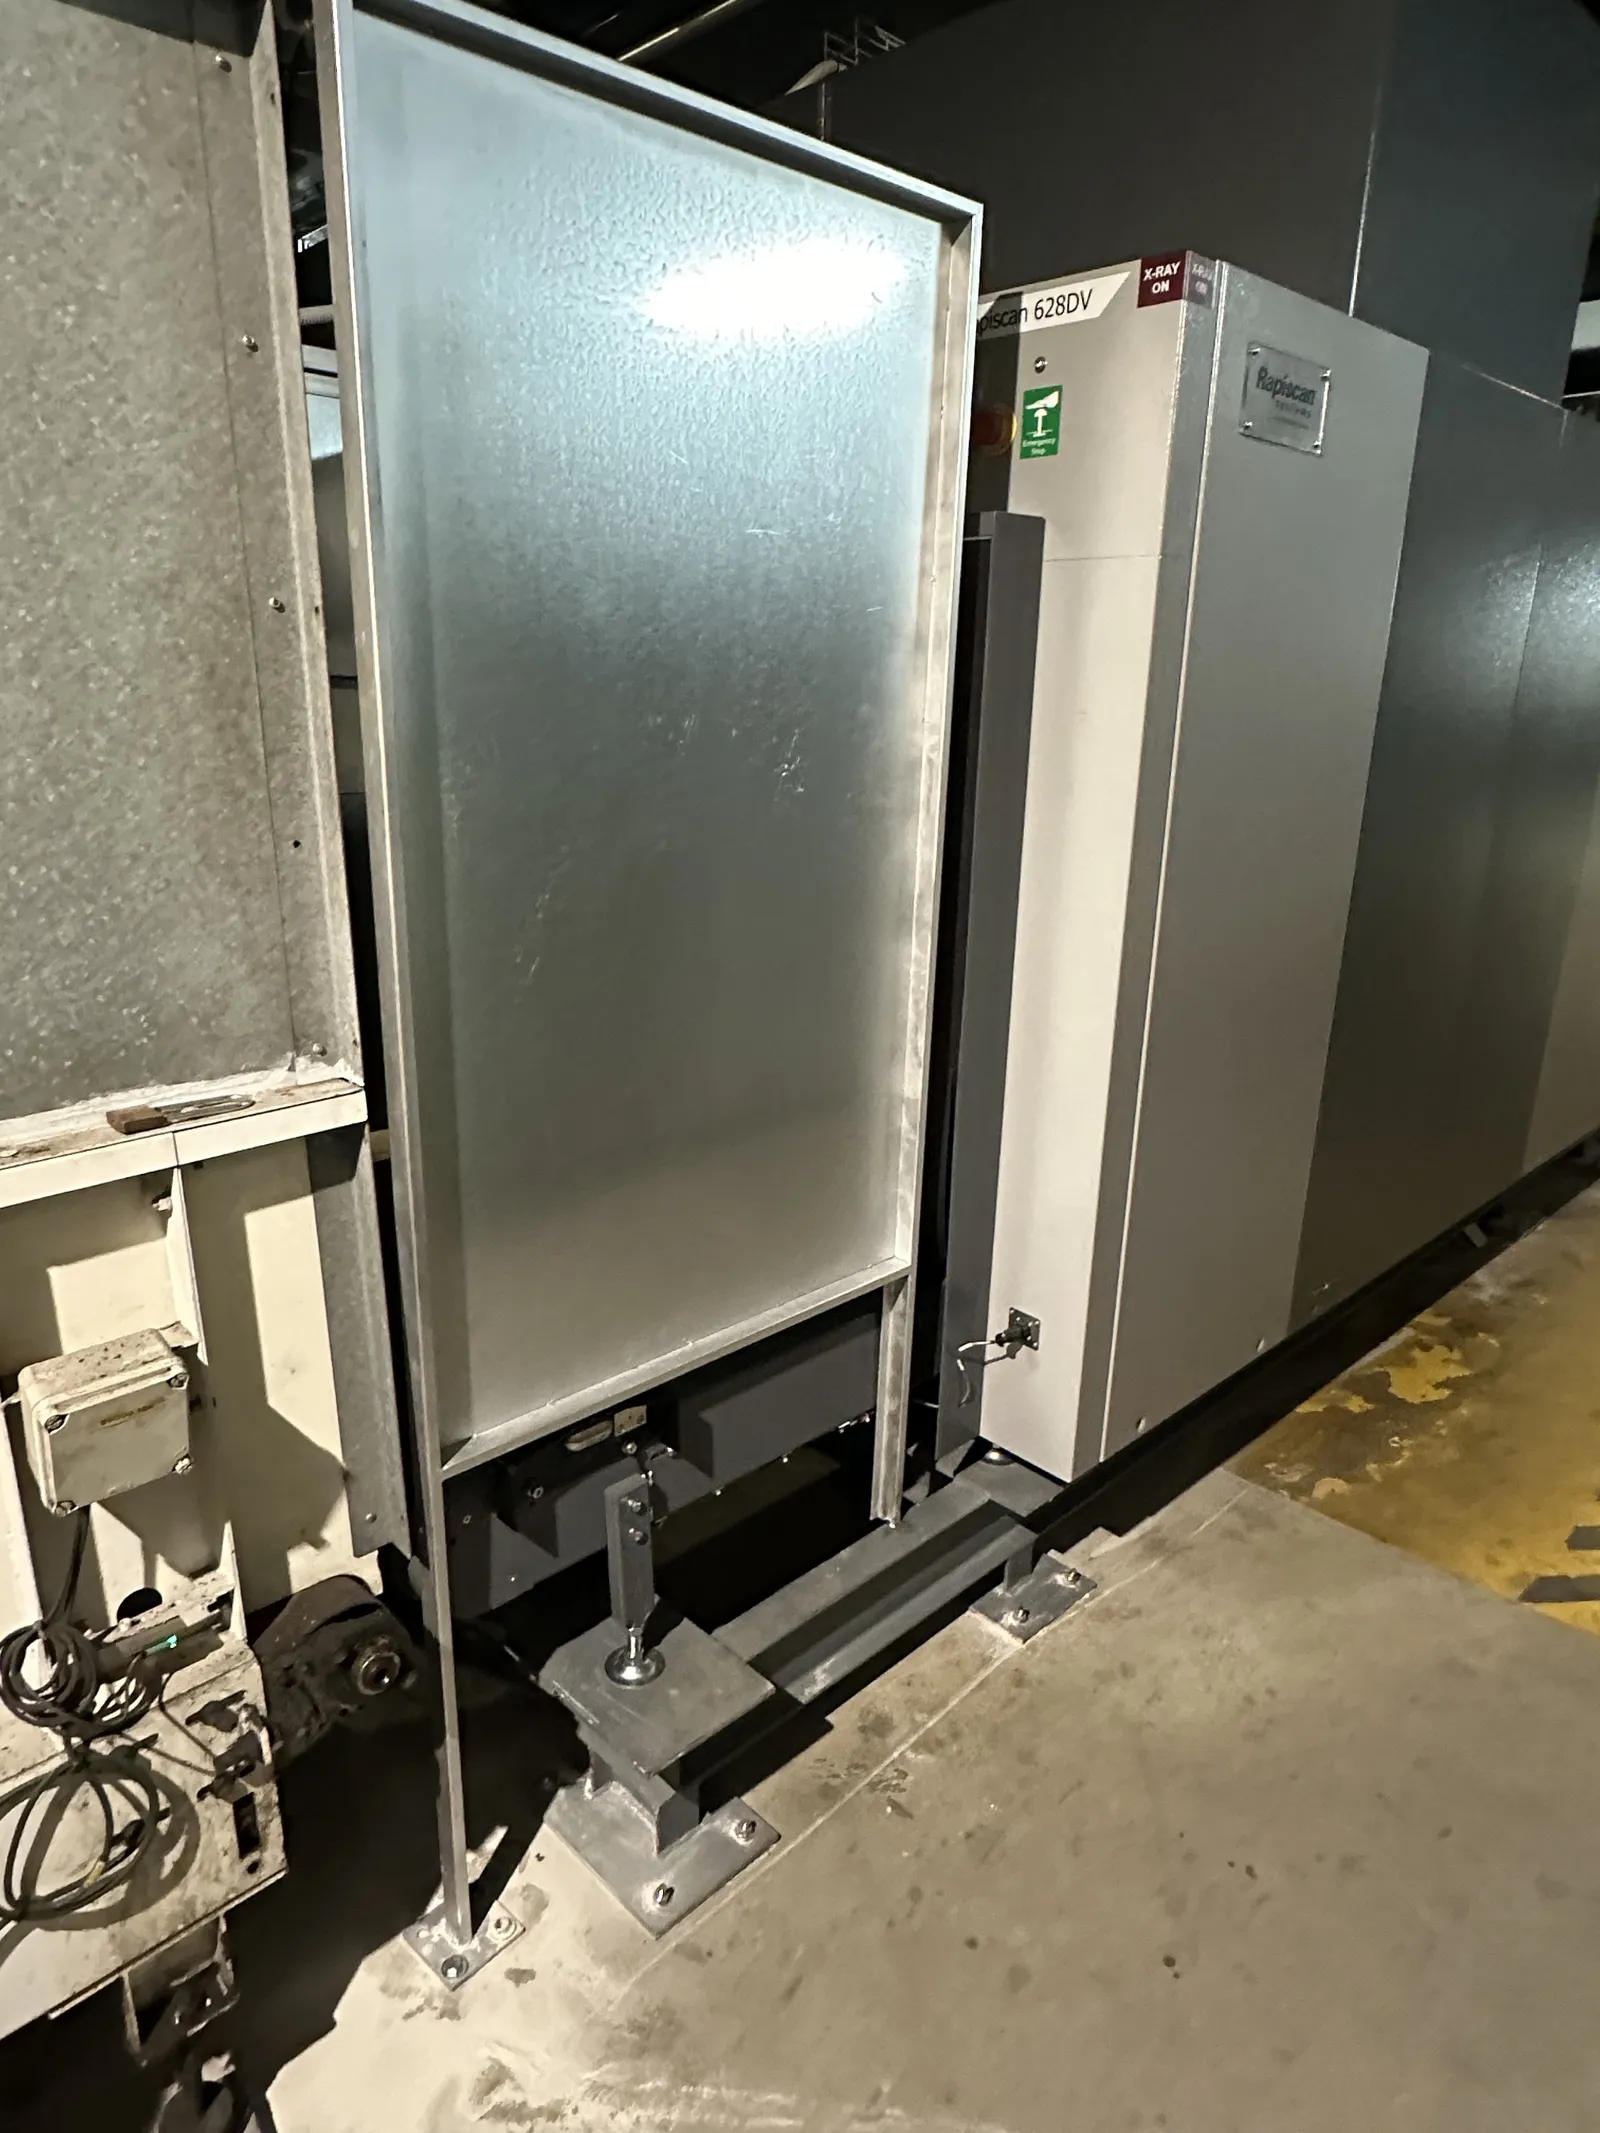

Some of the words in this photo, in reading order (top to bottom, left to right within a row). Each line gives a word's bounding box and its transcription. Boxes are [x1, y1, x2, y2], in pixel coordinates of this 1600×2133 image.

[1143, 260, 1181, 281] X-RAY
[1151, 279, 1171, 294] ON
[977, 307, 1028, 338] piscan
[1034, 288, 1093, 320] 628DV
[1256, 366, 1317, 405] Rapiscan
